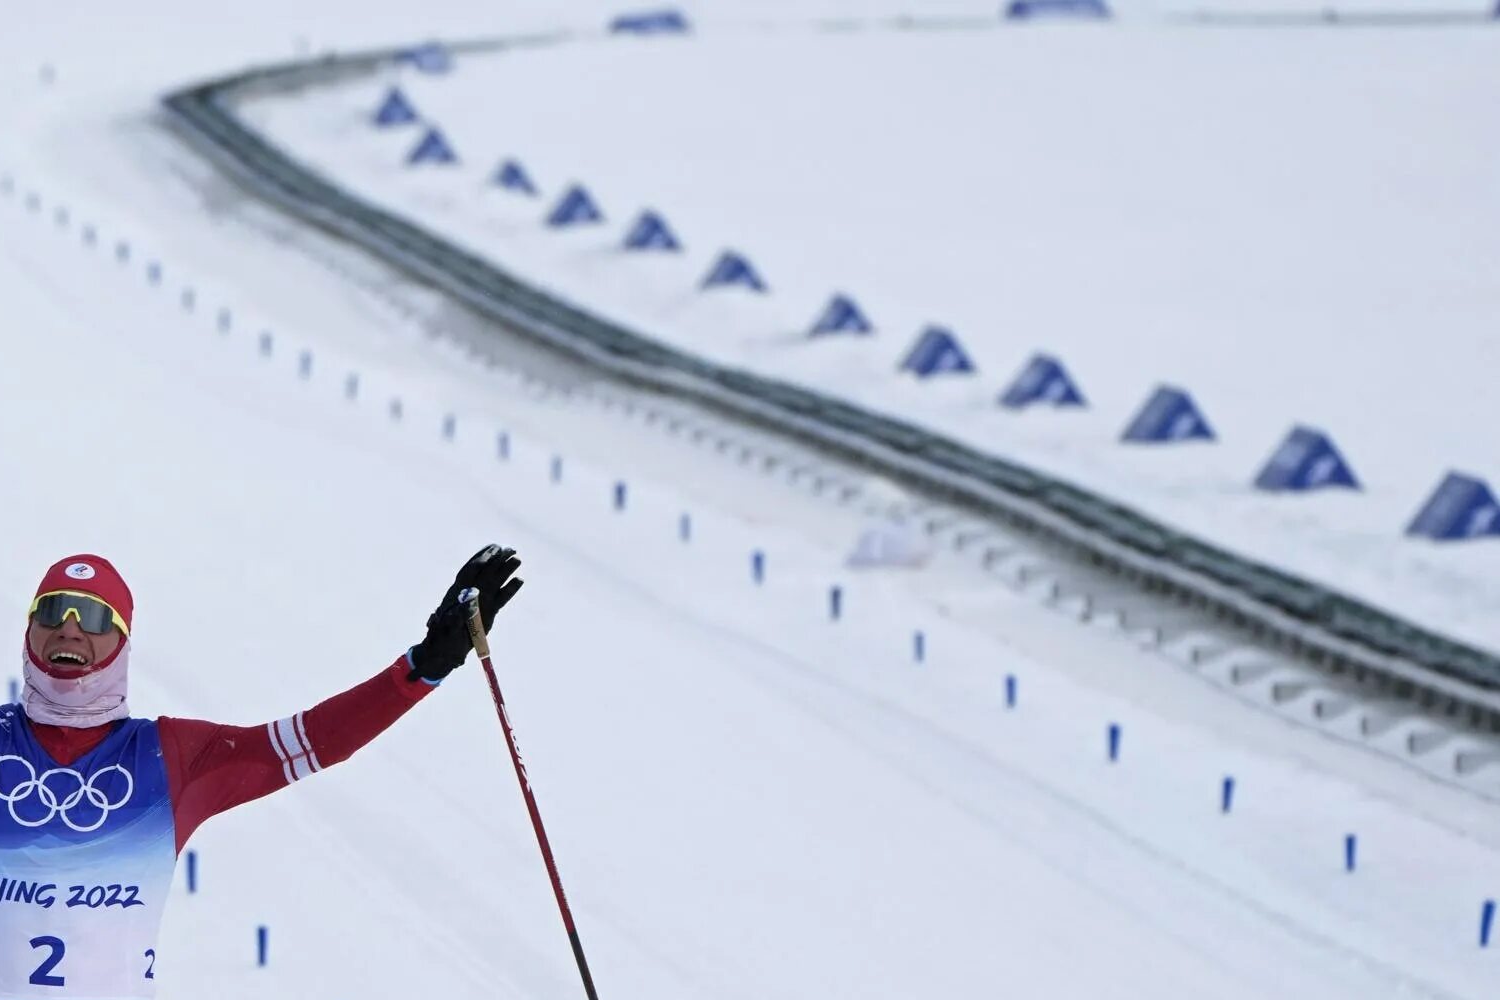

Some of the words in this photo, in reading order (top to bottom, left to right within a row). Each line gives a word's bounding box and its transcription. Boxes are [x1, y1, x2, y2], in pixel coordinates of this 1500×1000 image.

[65, 884, 145, 909] 2022
[29, 935, 66, 987] 2
[144, 948, 156, 980] 2
